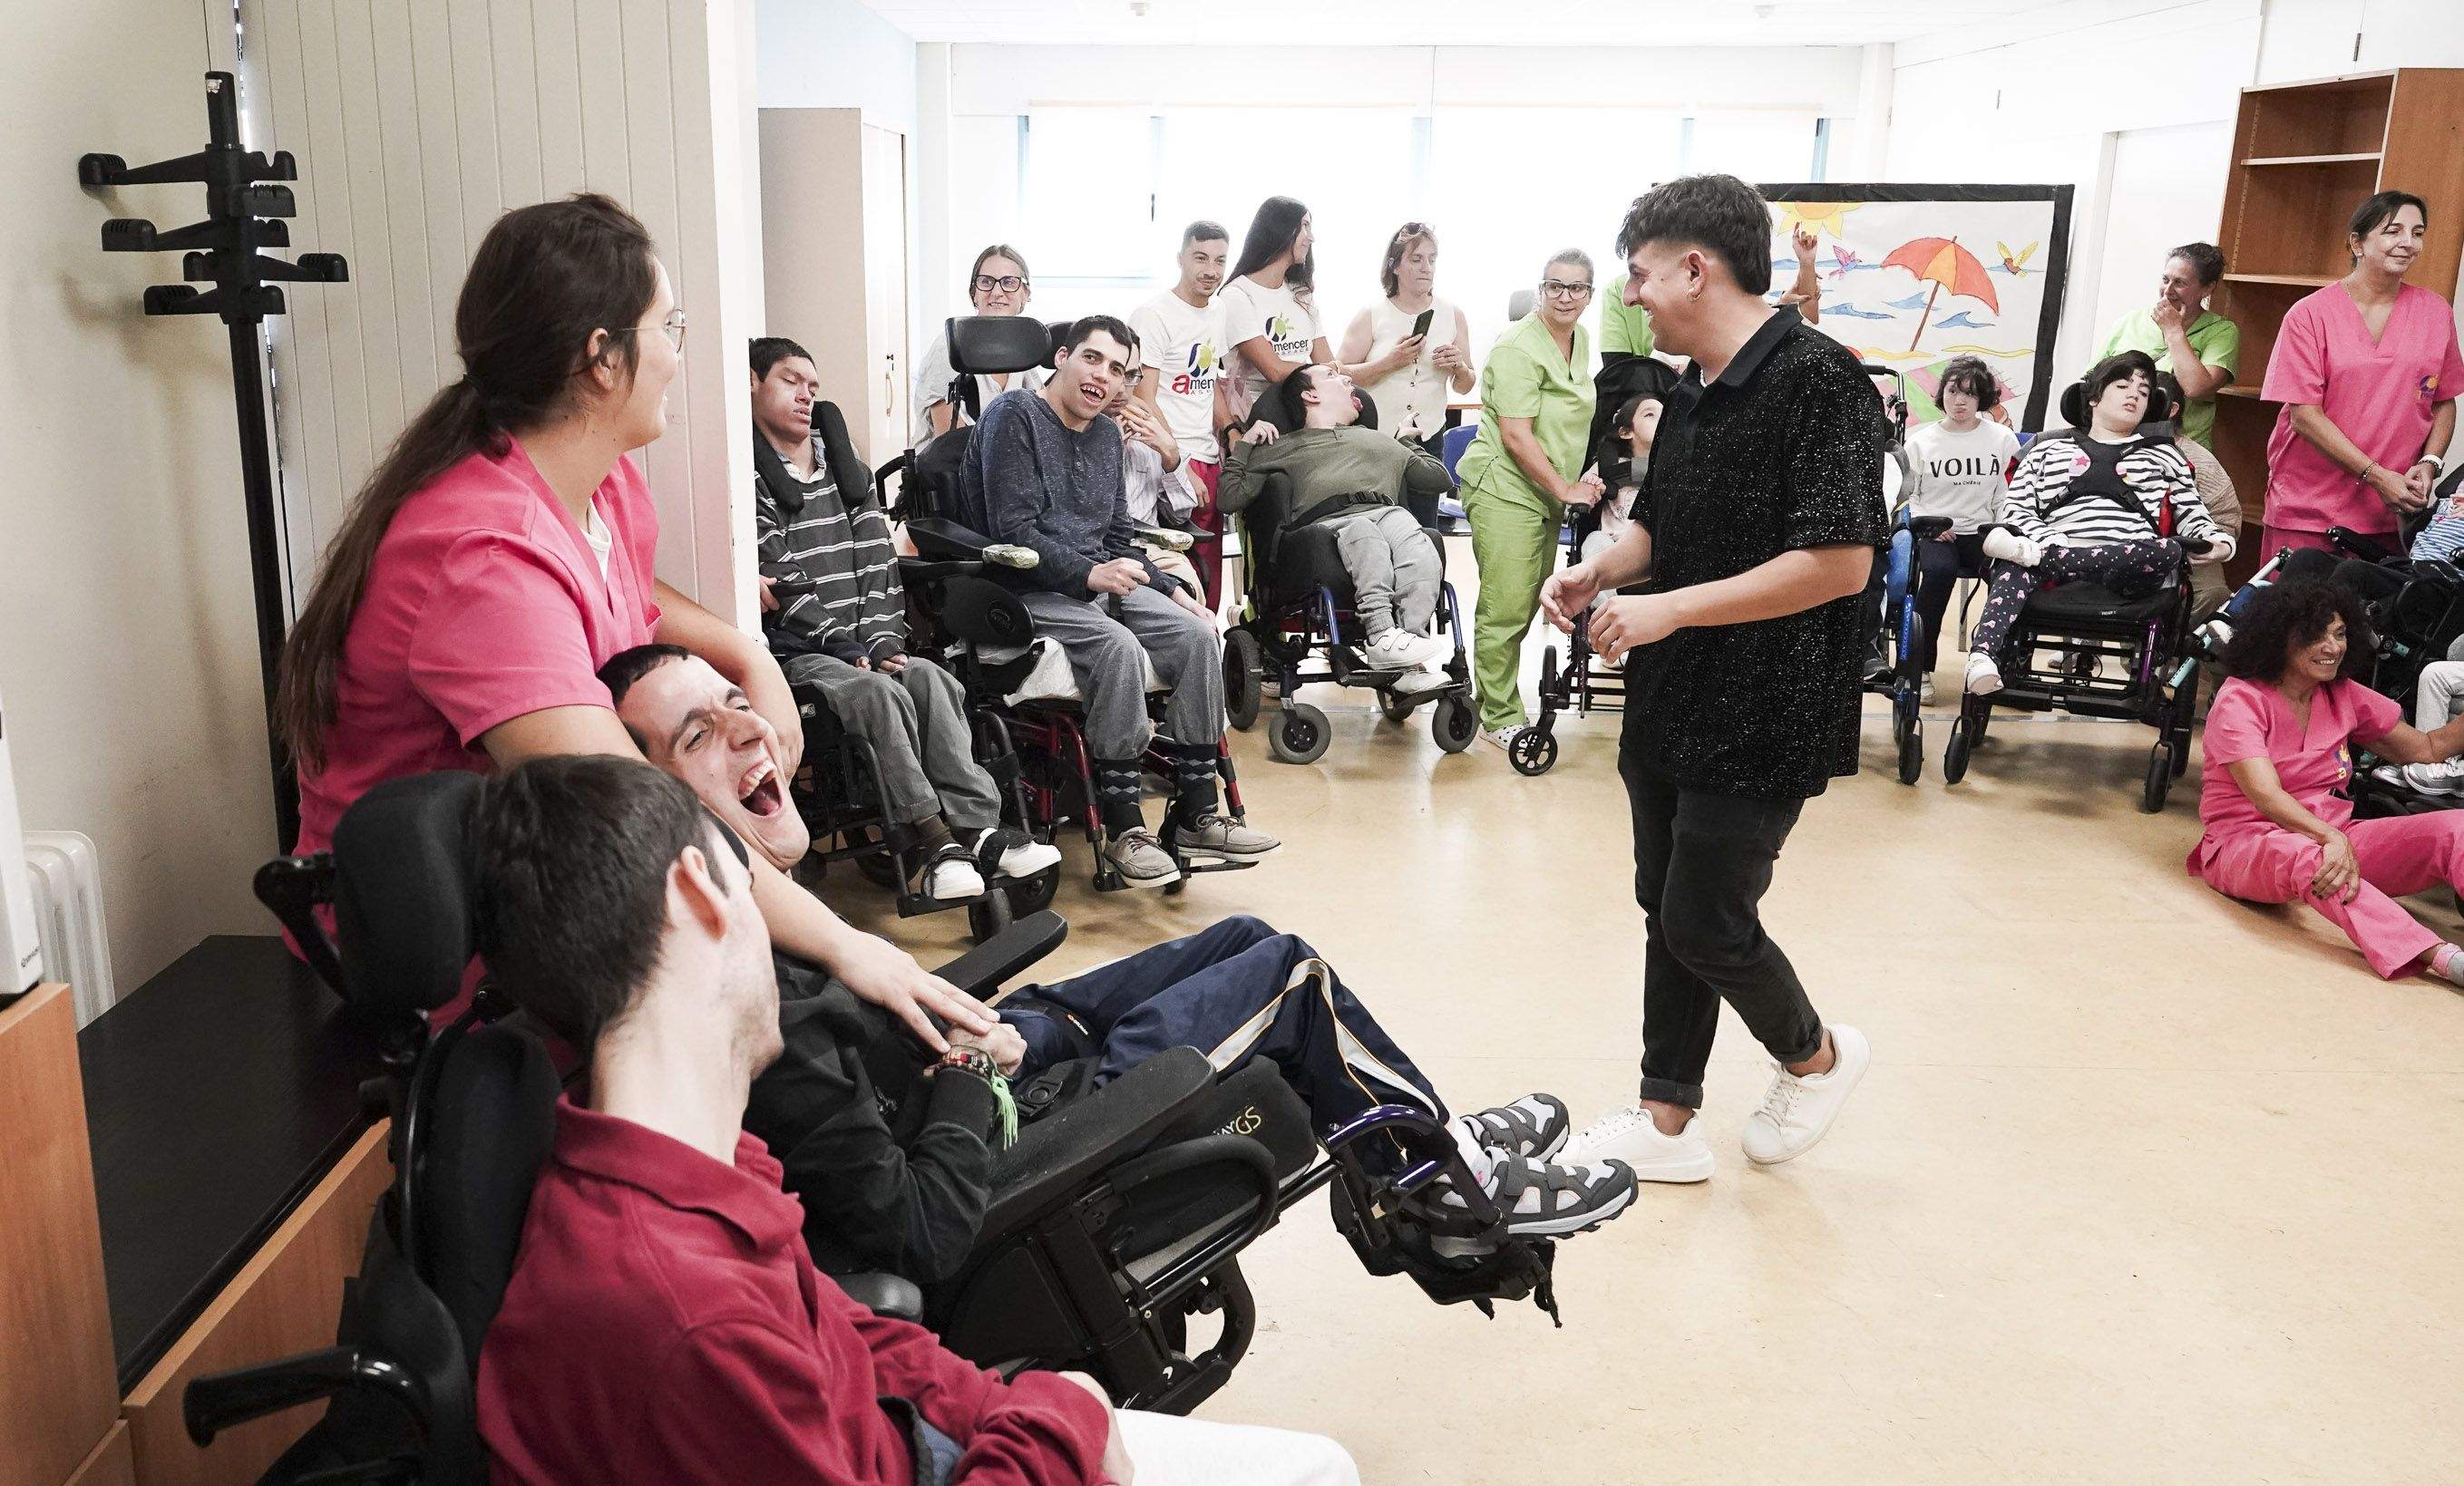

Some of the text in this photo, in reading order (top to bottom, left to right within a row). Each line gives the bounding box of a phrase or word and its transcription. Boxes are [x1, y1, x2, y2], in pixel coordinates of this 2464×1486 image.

[1273, 339, 1309, 352] mencer
[1172, 374, 1215, 394] amen
[1930, 454, 2001, 478] VOILÀ
